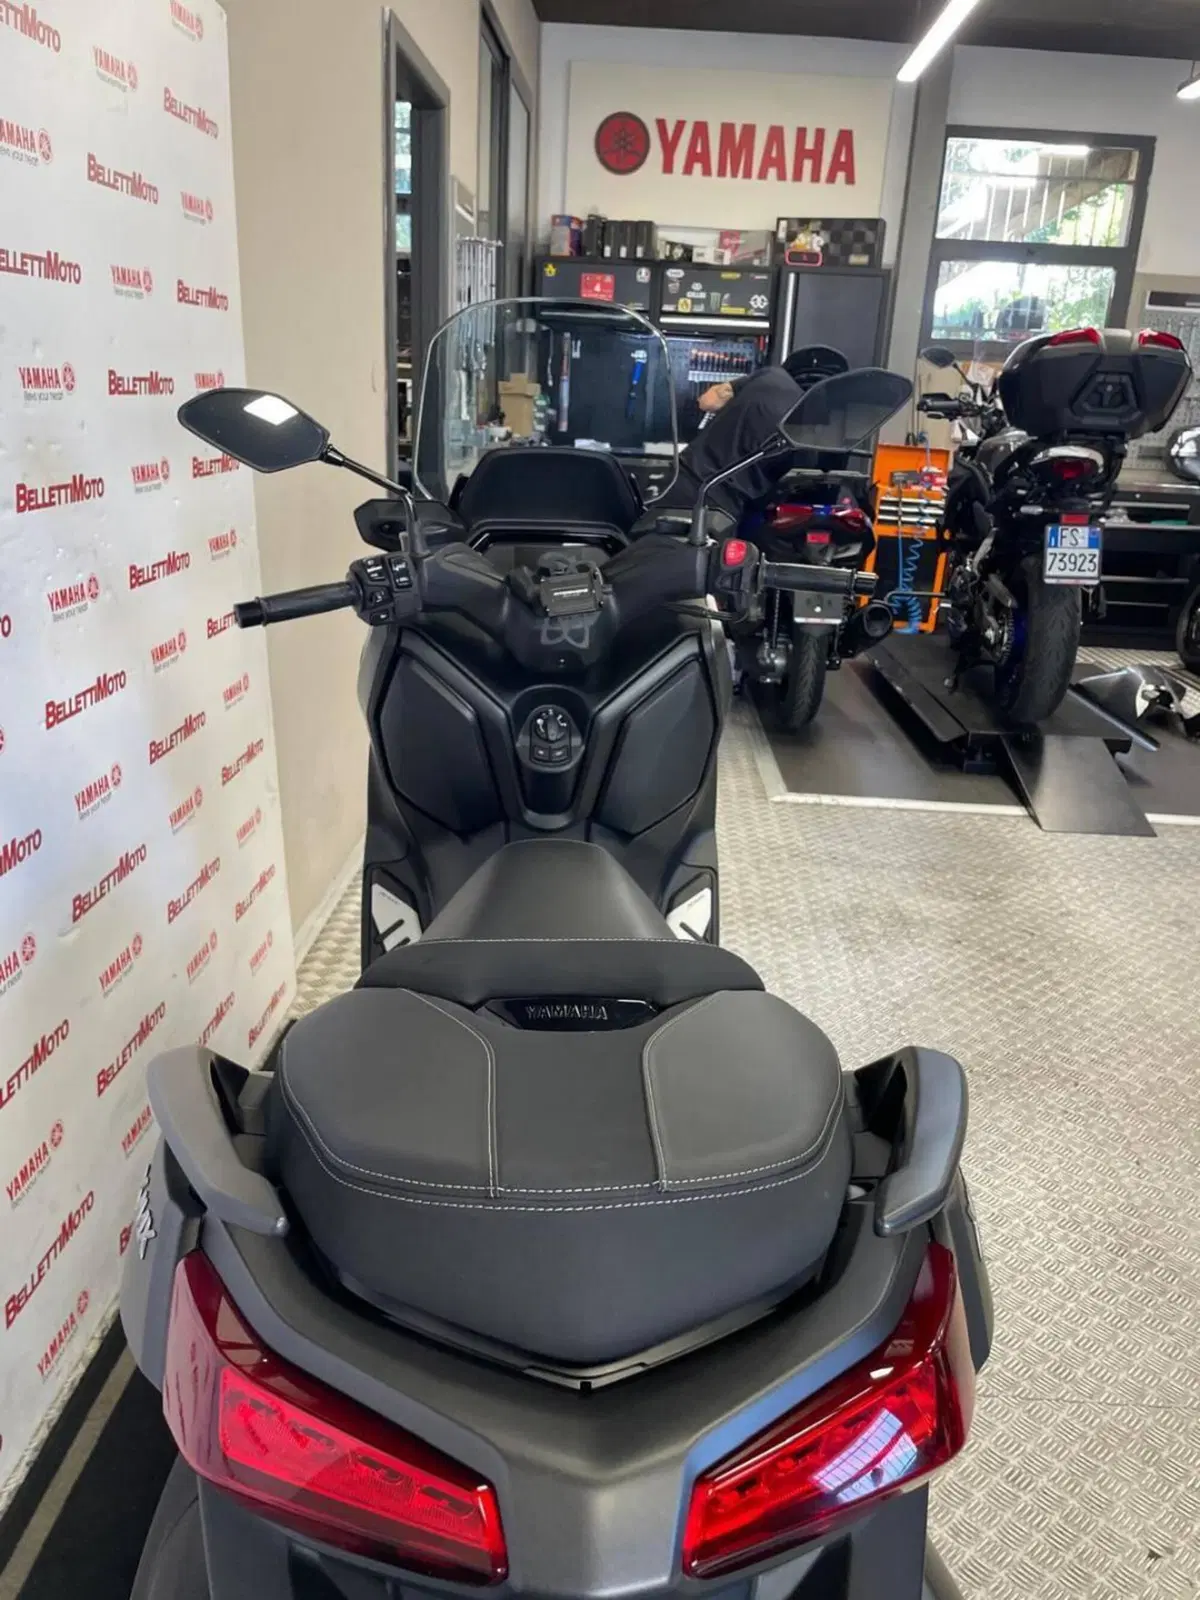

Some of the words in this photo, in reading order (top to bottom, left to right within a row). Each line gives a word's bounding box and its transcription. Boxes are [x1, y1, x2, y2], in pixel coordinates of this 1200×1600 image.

[656, 118, 856, 185] YAMAHA
[88, 152, 159, 204] BELLETTIMOTO
[110, 265, 142, 289] YAMAHA
[18, 366, 61, 389] YAMAHA
[108, 370, 175, 395] BELLETTIMOTO
[132, 463, 159, 484] YAMAHA
[16, 473, 105, 513] BELLETTIMOTO
[1060, 528, 1079, 547] FS
[129, 551, 190, 589] BELLETTIMOTO
[1048, 552, 1097, 572] 73923
[47, 582, 86, 612] YAMAHA
[151, 637, 177, 665] YAMAHA
[45, 670, 127, 730] BELLETTIMOTO
[149, 711, 206, 765] BELLETTIMOTO
[75, 774, 110, 811] YAMAHA
[169, 796, 194, 828] YAMAHA
[72, 844, 147, 923] BELLETTIMOTO
[168, 856, 221, 924] BELLETTIMOTO
[99, 947, 132, 991] YAMAHA
[186, 944, 210, 980] YAMAHA
[525, 1004, 608, 1020] YAMAHA
[96, 1001, 166, 1098] BELLETTIMOTO
[6, 1139, 49, 1200] YAMAHA
[5, 1190, 95, 1330] BELLETTIMOTO
[37, 1312, 76, 1377] YAMAHA
